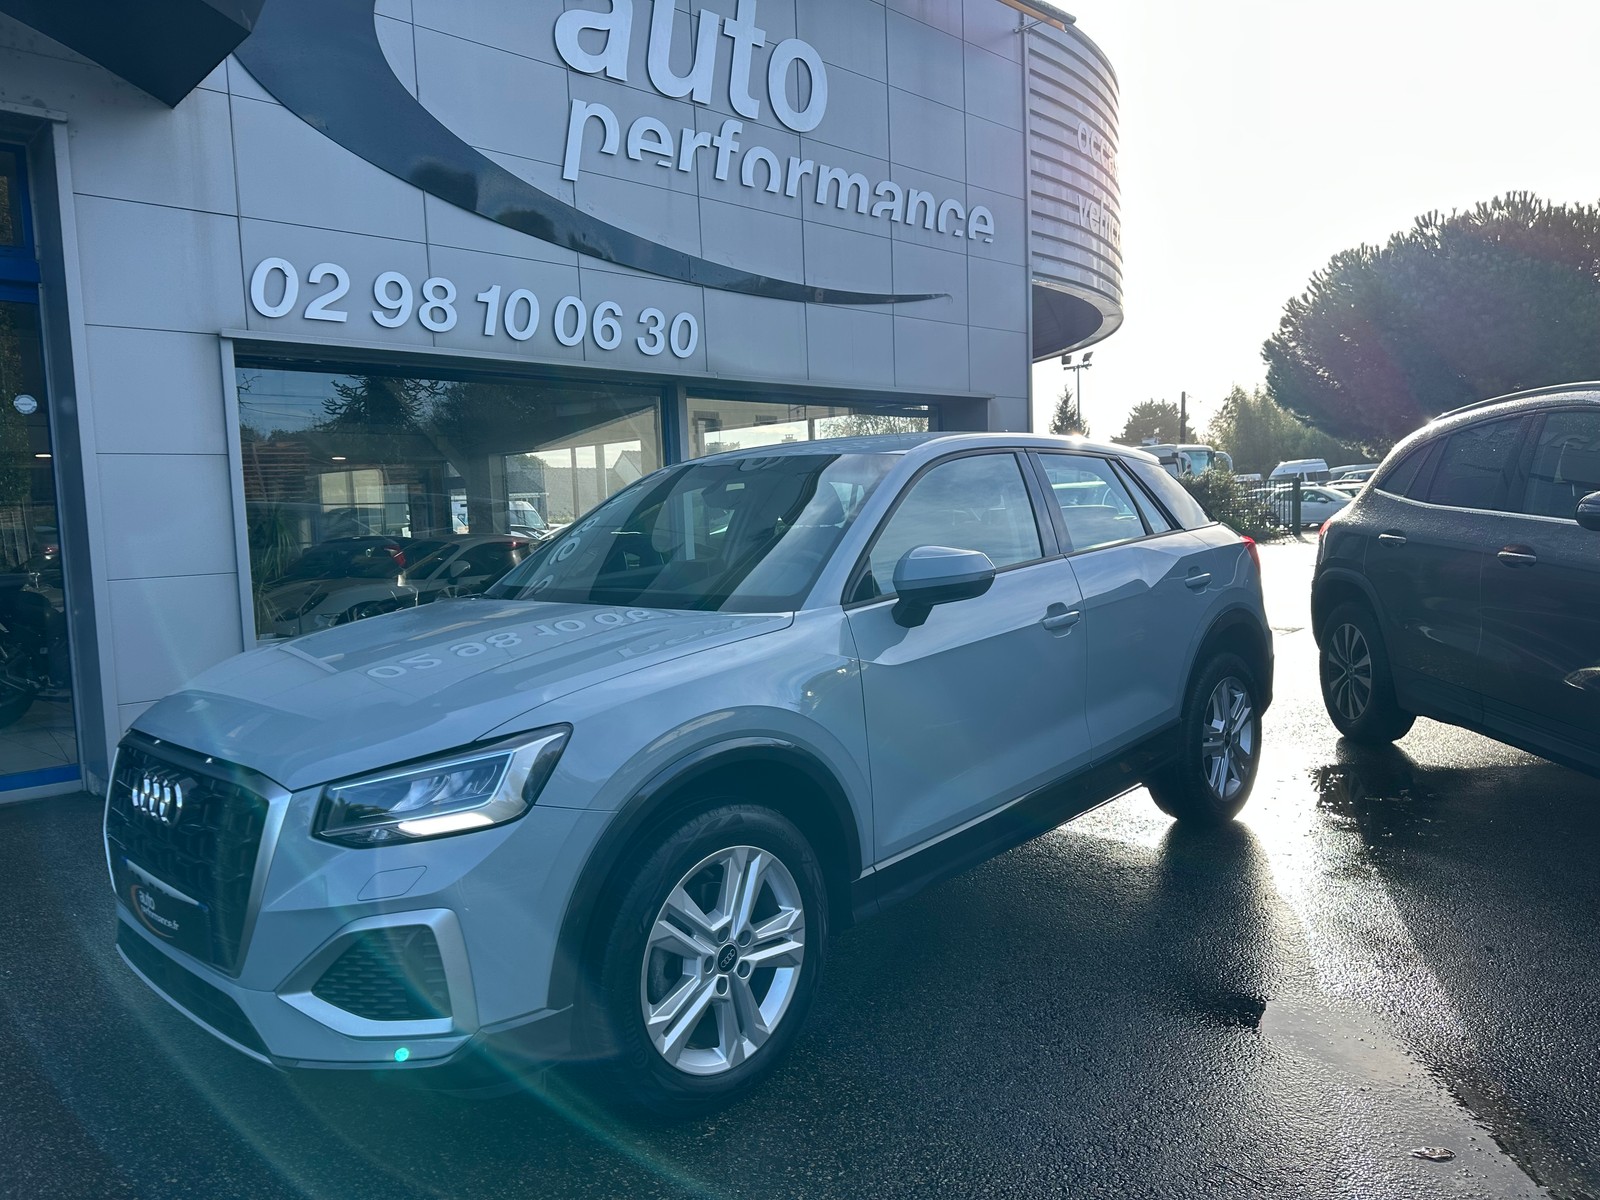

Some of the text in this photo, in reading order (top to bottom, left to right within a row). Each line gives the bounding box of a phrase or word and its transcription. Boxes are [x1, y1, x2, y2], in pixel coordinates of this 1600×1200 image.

[554, 0, 828, 133] auto
[562, 98, 995, 244] performance
[250, 256, 700, 359] 02 98 10 06 30
